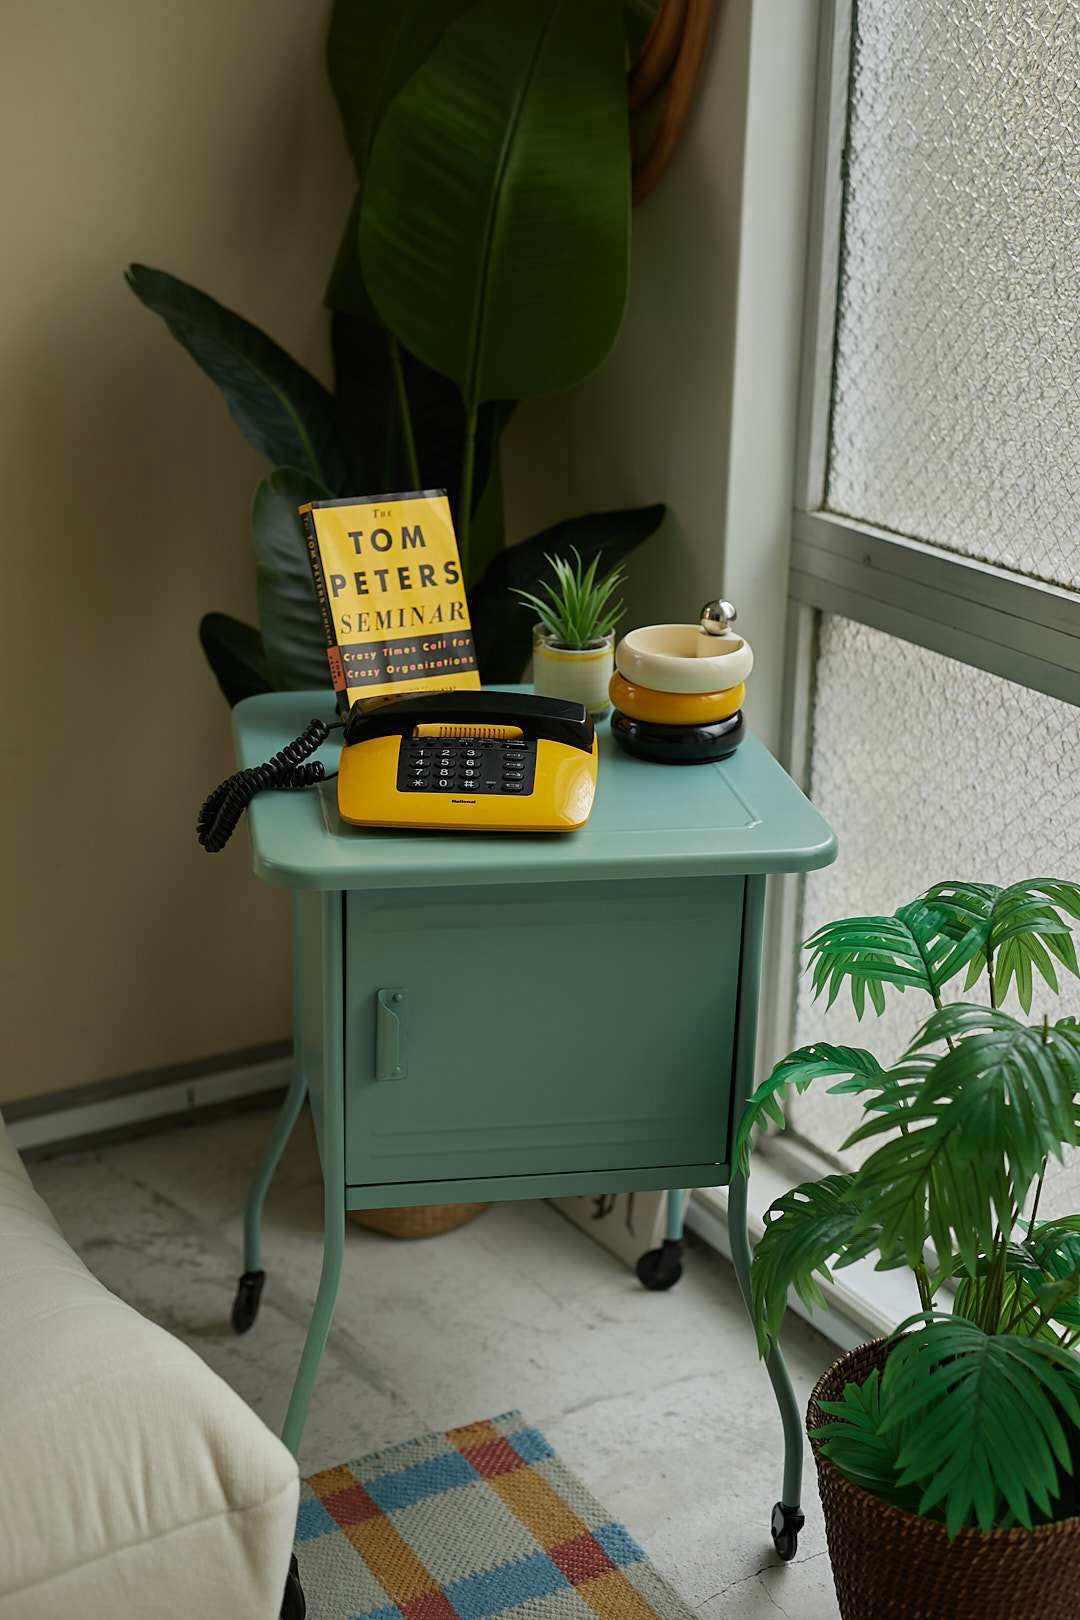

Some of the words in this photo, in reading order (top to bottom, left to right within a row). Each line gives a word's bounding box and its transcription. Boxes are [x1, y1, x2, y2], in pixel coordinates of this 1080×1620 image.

[347, 525, 427, 555] TOM
[329, 560, 460, 598] PETERS
[340, 601, 466, 635] SEMINAR
[343, 651, 377, 662] Crazy
[383, 646, 417, 657] Times
[422, 640, 447, 651] Call
[452, 638, 471, 647] for
[347, 667, 380, 679] Crazy
[386, 656, 475, 674] Organizations
[415, 768, 424, 776] 7
[465, 769, 474, 777] 9
[439, 779, 448, 787] 0
[463, 780, 475, 788] #
